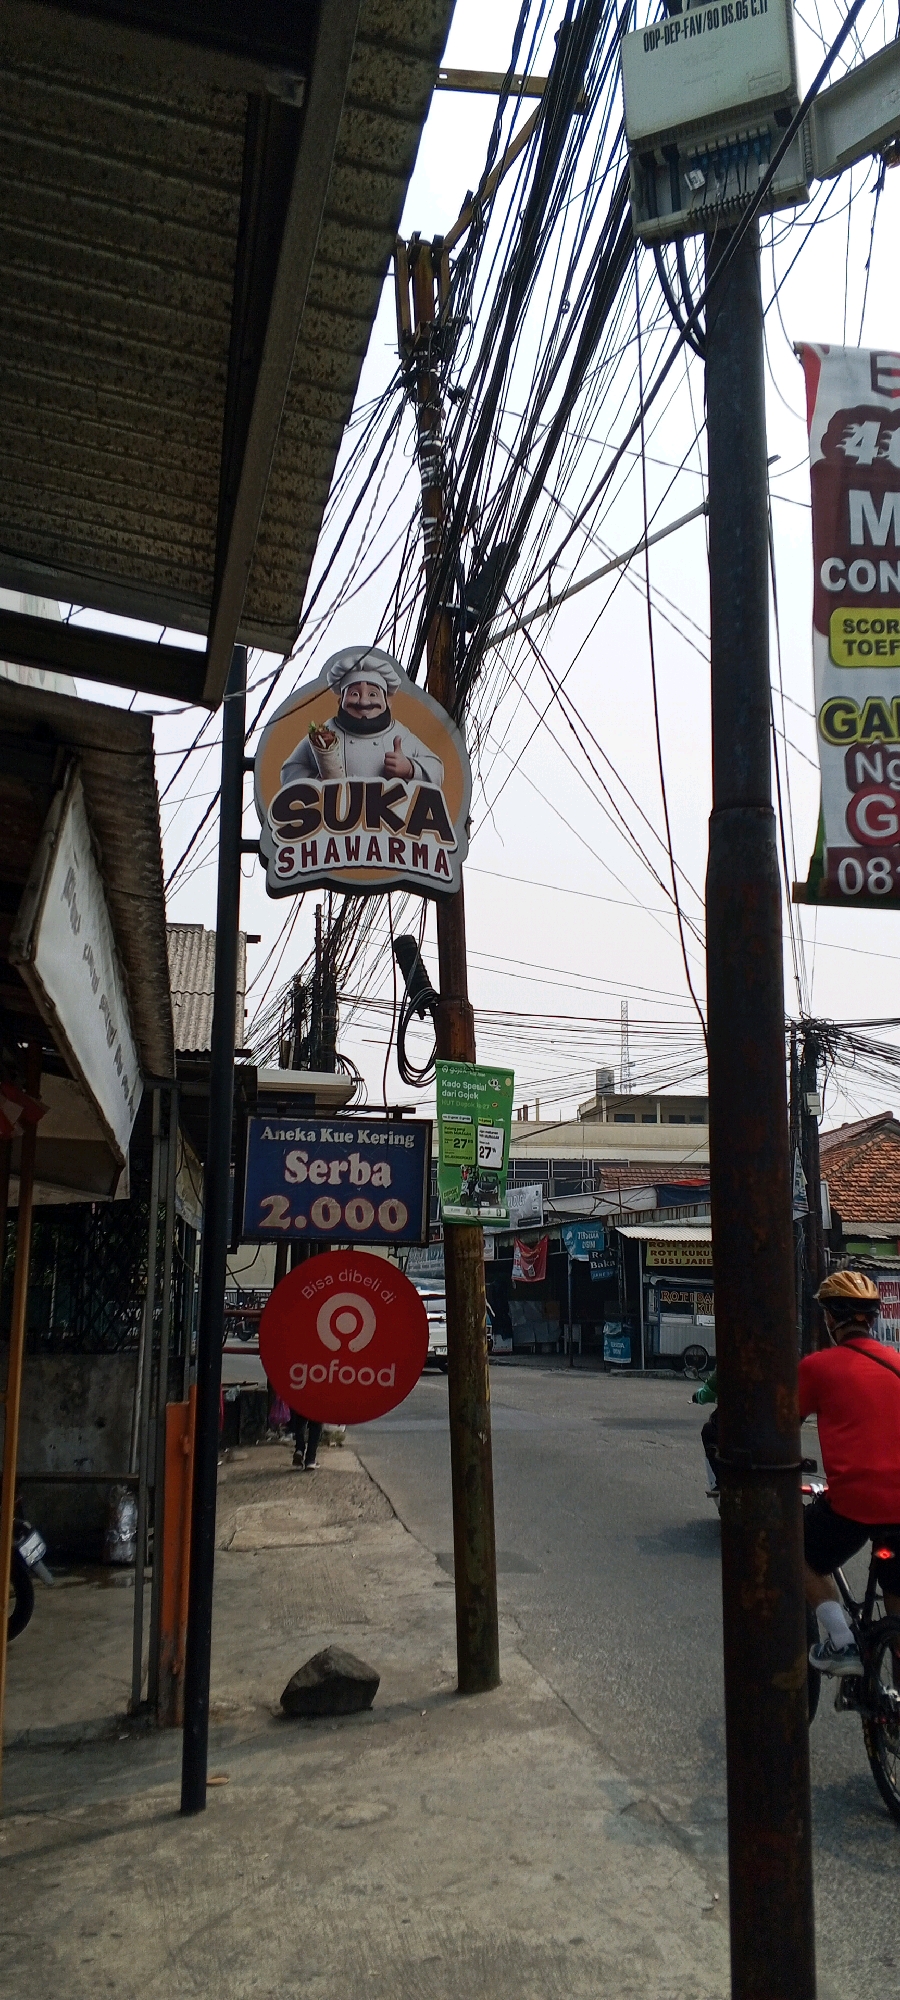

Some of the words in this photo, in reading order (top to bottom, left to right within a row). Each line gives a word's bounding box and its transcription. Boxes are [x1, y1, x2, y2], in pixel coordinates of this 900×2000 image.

[271, 780, 455, 843] SUKA
[277, 835, 450, 877] SHAWARMA
[837, 855, 900, 895] 08
[441, 1079, 461, 1089] Kado
[441, 1089, 457, 1098] dari
[457, 1090, 479, 1101] Gojek
[260, 1126, 316, 1142] Aneka
[320, 1128, 354, 1143] Kue
[356, 1129, 415, 1149] Kering
[284, 1150, 392, 1189] Serba
[258, 1195, 408, 1232] 2.000
[301, 1275, 334, 1300] Bisa
[338, 1269, 382, 1292] dibeli
[380, 1289, 397, 1305] di
[289, 1359, 396, 1391] gofood
